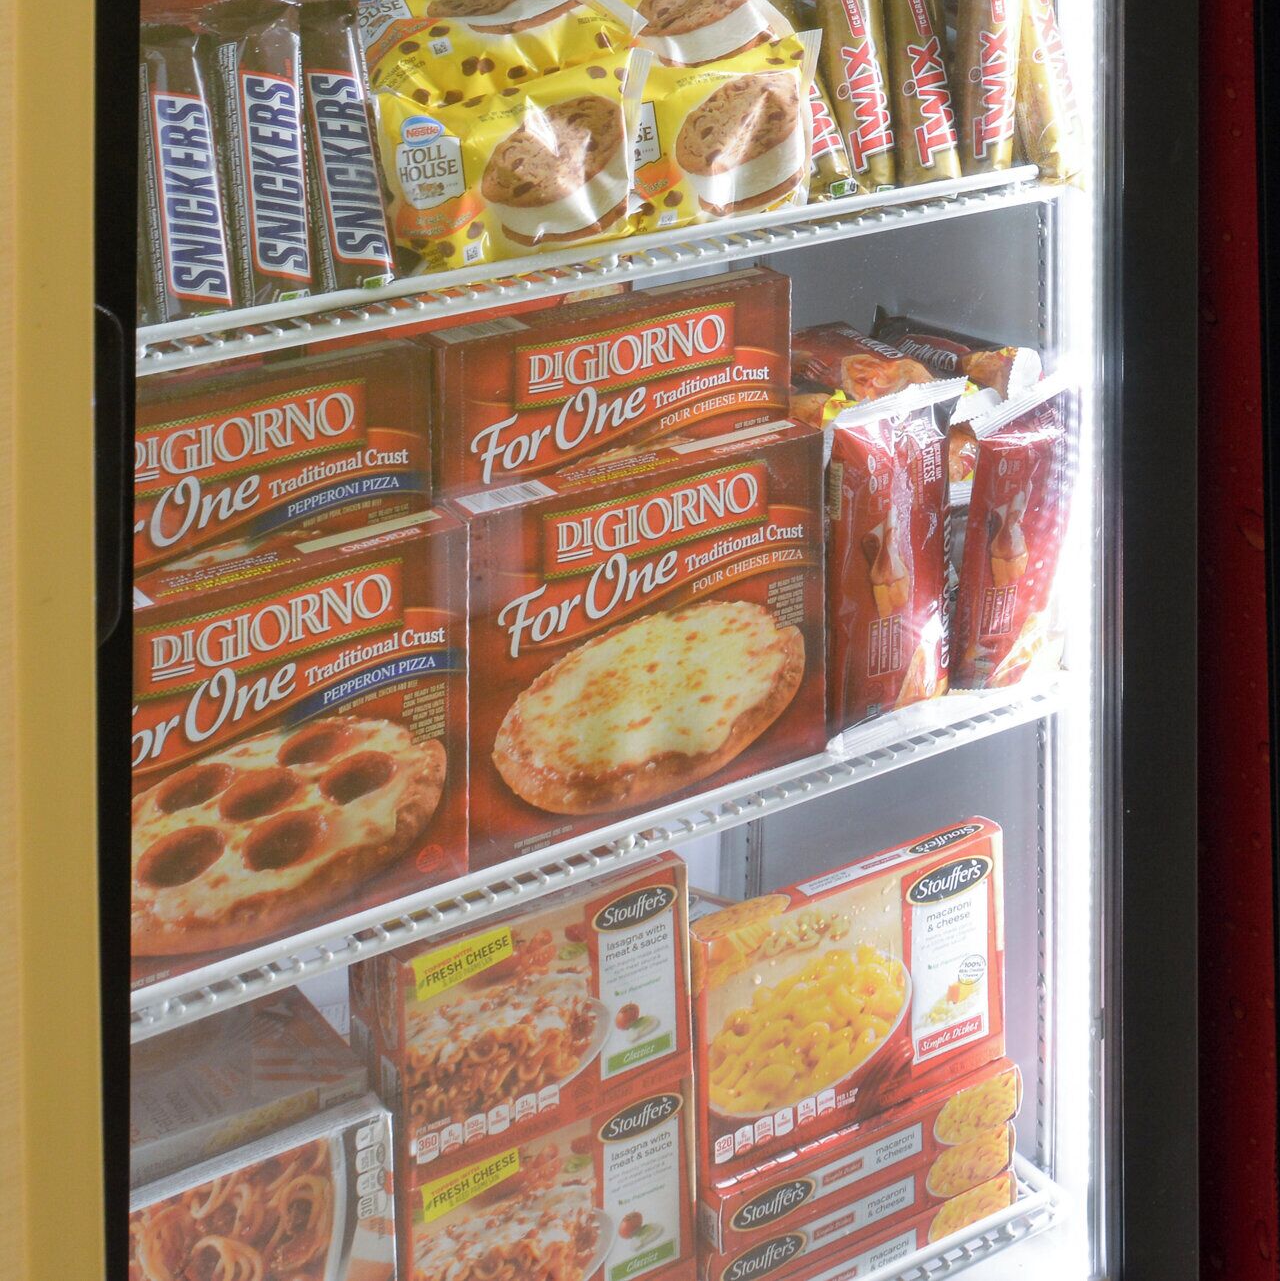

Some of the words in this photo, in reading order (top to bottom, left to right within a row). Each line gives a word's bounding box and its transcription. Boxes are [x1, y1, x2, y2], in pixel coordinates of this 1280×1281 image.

[853, 16, 861, 28] ICE
[919, 16, 928, 29] ICE
[838, 40, 895, 174] TWIX
[903, 35, 958, 168] TWIX
[969, 28, 1015, 160] TWIX
[308, 72, 391, 265] SNICKERS
[401, 158, 459, 184] HOUSE
[403, 144, 447, 166] TOLL
[246, 74, 311, 277] SNICKERS
[155, 95, 229, 298] SNICKERS
[470, 412, 551, 485] For
[555, 386, 647, 450] One
[653, 368, 731, 409] Traditional
[732, 365, 769, 382] Crust
[660, 407, 691, 430] FOUR
[693, 394, 736, 416] CHEESE
[738, 389, 770, 404] PIZZA
[922, 442, 936, 486] CHEESE
[150, 474, 261, 548] One
[268, 450, 362, 500] Traditional
[364, 448, 409, 467] Crust
[287, 483, 360, 518] PEPPERONI
[362, 475, 400, 498] PIZZA
[497, 583, 581, 658] For
[585, 549, 678, 620] One
[685, 530, 764, 573] Traditional
[766, 523, 804, 541] Crust
[692, 570, 723, 594] FOUR
[725, 555, 770, 580] CHEESE
[771, 548, 804, 563] PIZZA
[186, 662, 297, 743] One
[305, 638, 400, 687] Traditional
[402, 626, 446, 648] Crust
[323, 664, 398, 704] PEPPERONI
[399, 655, 436, 677] PIZZA
[916, 859, 982, 899] Stouffer's
[603, 888, 667, 927] Stouffer's
[926, 900, 973, 923] macaroni
[927, 924, 934, 934] &
[936, 911, 971, 931] cheese
[605, 947, 632, 963] meat
[640, 933, 668, 948] sauce
[606, 932, 644, 951] lasagna
[646, 923, 666, 936] with
[425, 960, 464, 988] FRESH
[466, 934, 511, 966] CHEESE
[921, 1031, 952, 1052] Simple
[952, 1018, 980, 1041] Dishes
[608, 1096, 672, 1138] Stouffer's
[418, 1134, 438, 1152] 360
[609, 1156, 635, 1173] meat
[644, 1141, 673, 1157] sauce
[611, 1140, 649, 1162] lasagna
[651, 1130, 671, 1145] with
[716, 1138, 733, 1152] 320
[875, 1133, 915, 1155] macaroni
[883, 1143, 913, 1162] cheese
[432, 1181, 471, 1209] FRESH
[473, 1152, 517, 1183] CHEESE
[867, 1186, 907, 1210] macaroni
[740, 1183, 805, 1226] Stouffer's
[875, 1196, 905, 1215] cheese
[730, 1238, 796, 1281] Stouffer's
[869, 1239, 910, 1264] macaroni
[877, 1250, 908, 1269] cheese
